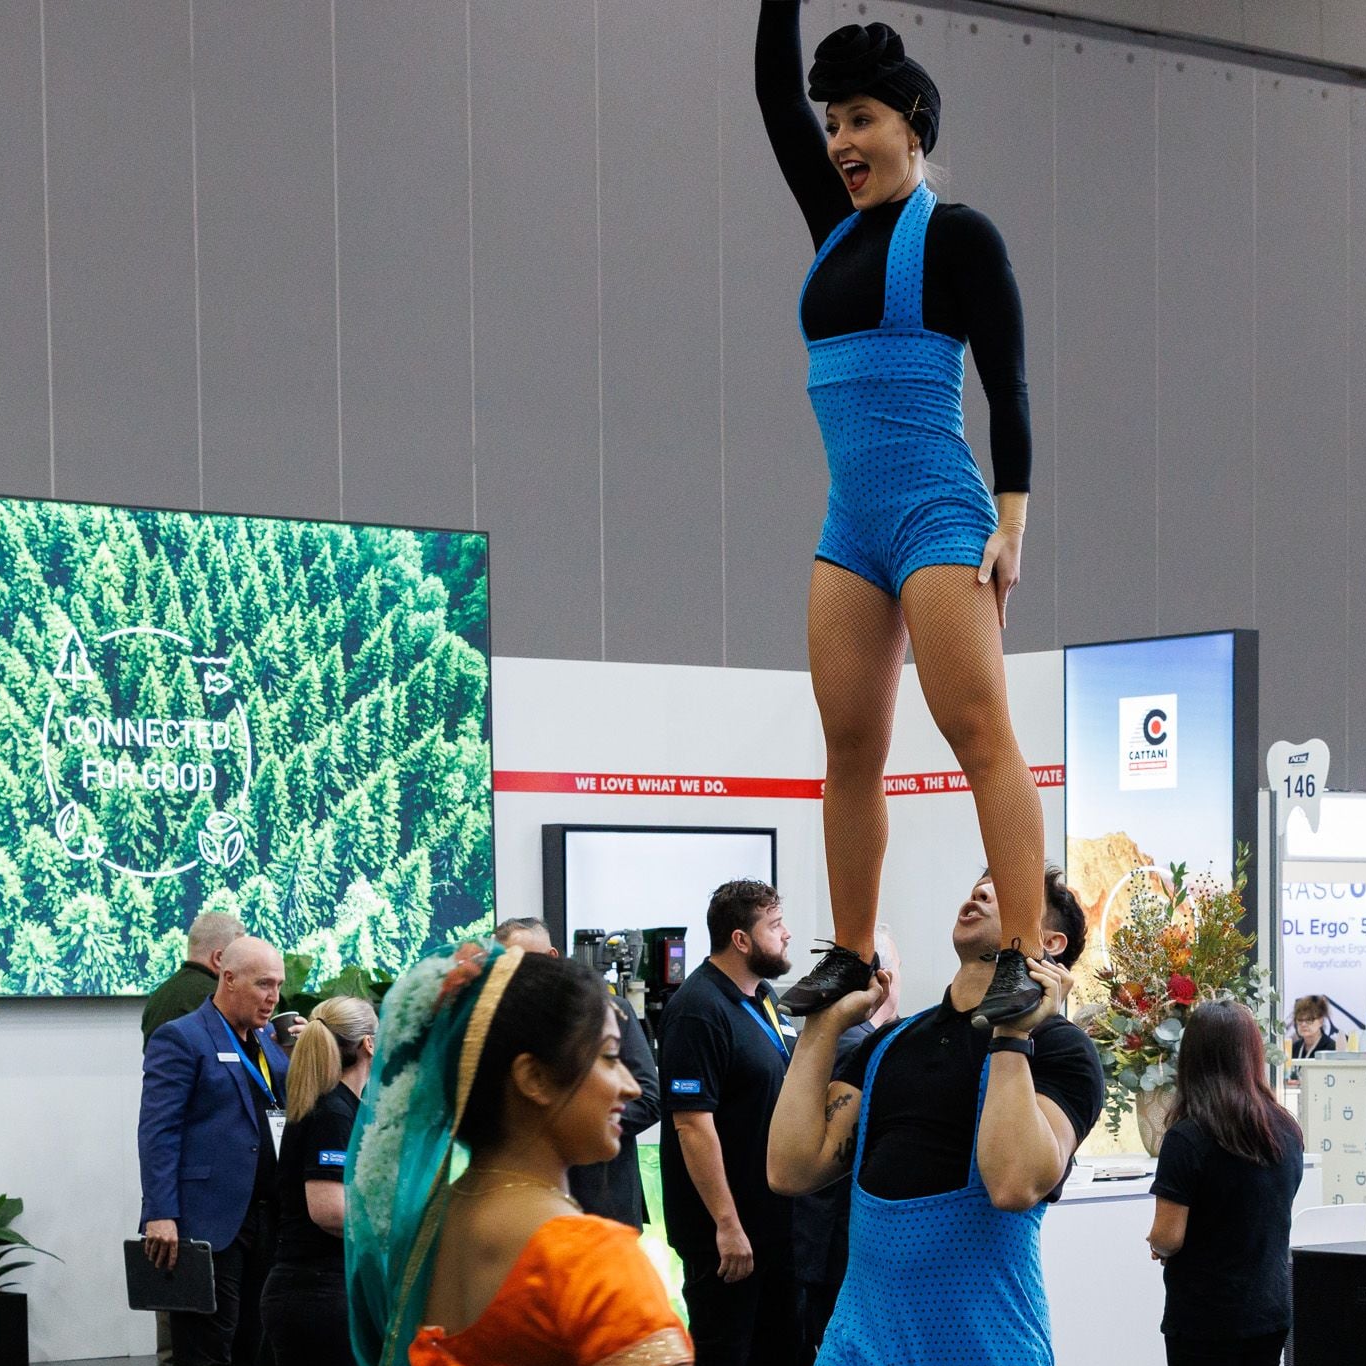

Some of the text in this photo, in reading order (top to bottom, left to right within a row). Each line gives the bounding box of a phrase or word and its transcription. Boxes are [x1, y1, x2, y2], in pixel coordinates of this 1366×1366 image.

[64, 715, 231, 750] CONNECTED
[1129, 749, 1167, 760] CATTANI
[82, 760, 217, 792] FOR GOOD
[575, 777, 597, 790] WE
[600, 777, 634, 791] LOVE
[637, 778, 677, 792] WHAT
[680, 779, 700, 793] WE
[704, 780, 728, 794] DO.
[884, 778, 920, 792] KING,
[922, 776, 944, 789] THE
[1283, 773, 1316, 799] 146
[1295, 945, 1312, 954] Our
[1313, 943, 1346, 956] highest
[1302, 958, 1362, 970] magnification
